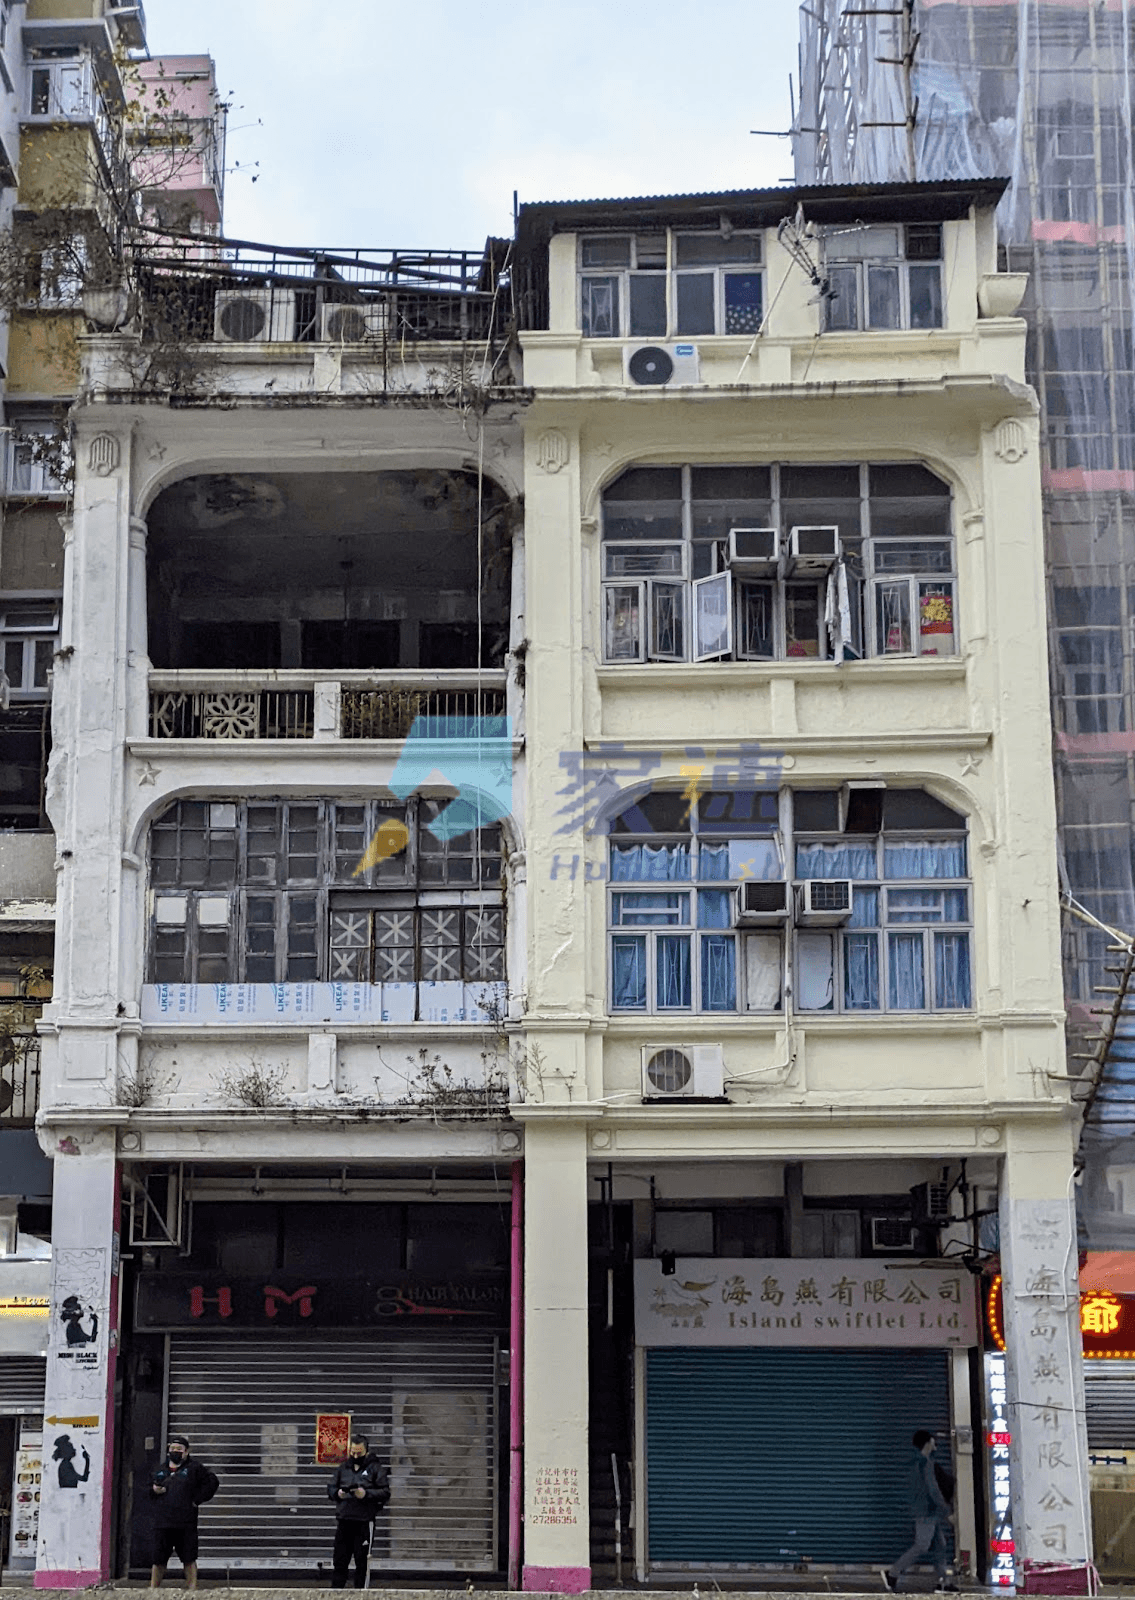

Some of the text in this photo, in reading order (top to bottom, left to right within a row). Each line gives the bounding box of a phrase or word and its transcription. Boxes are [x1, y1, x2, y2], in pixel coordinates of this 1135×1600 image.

[721, 1275, 962, 1307] 海島燕有限公司
[728, 1312, 969, 1329] Island swiftlet Ltd.
[1025, 1264, 1073, 1554] 海島燕有限公司
